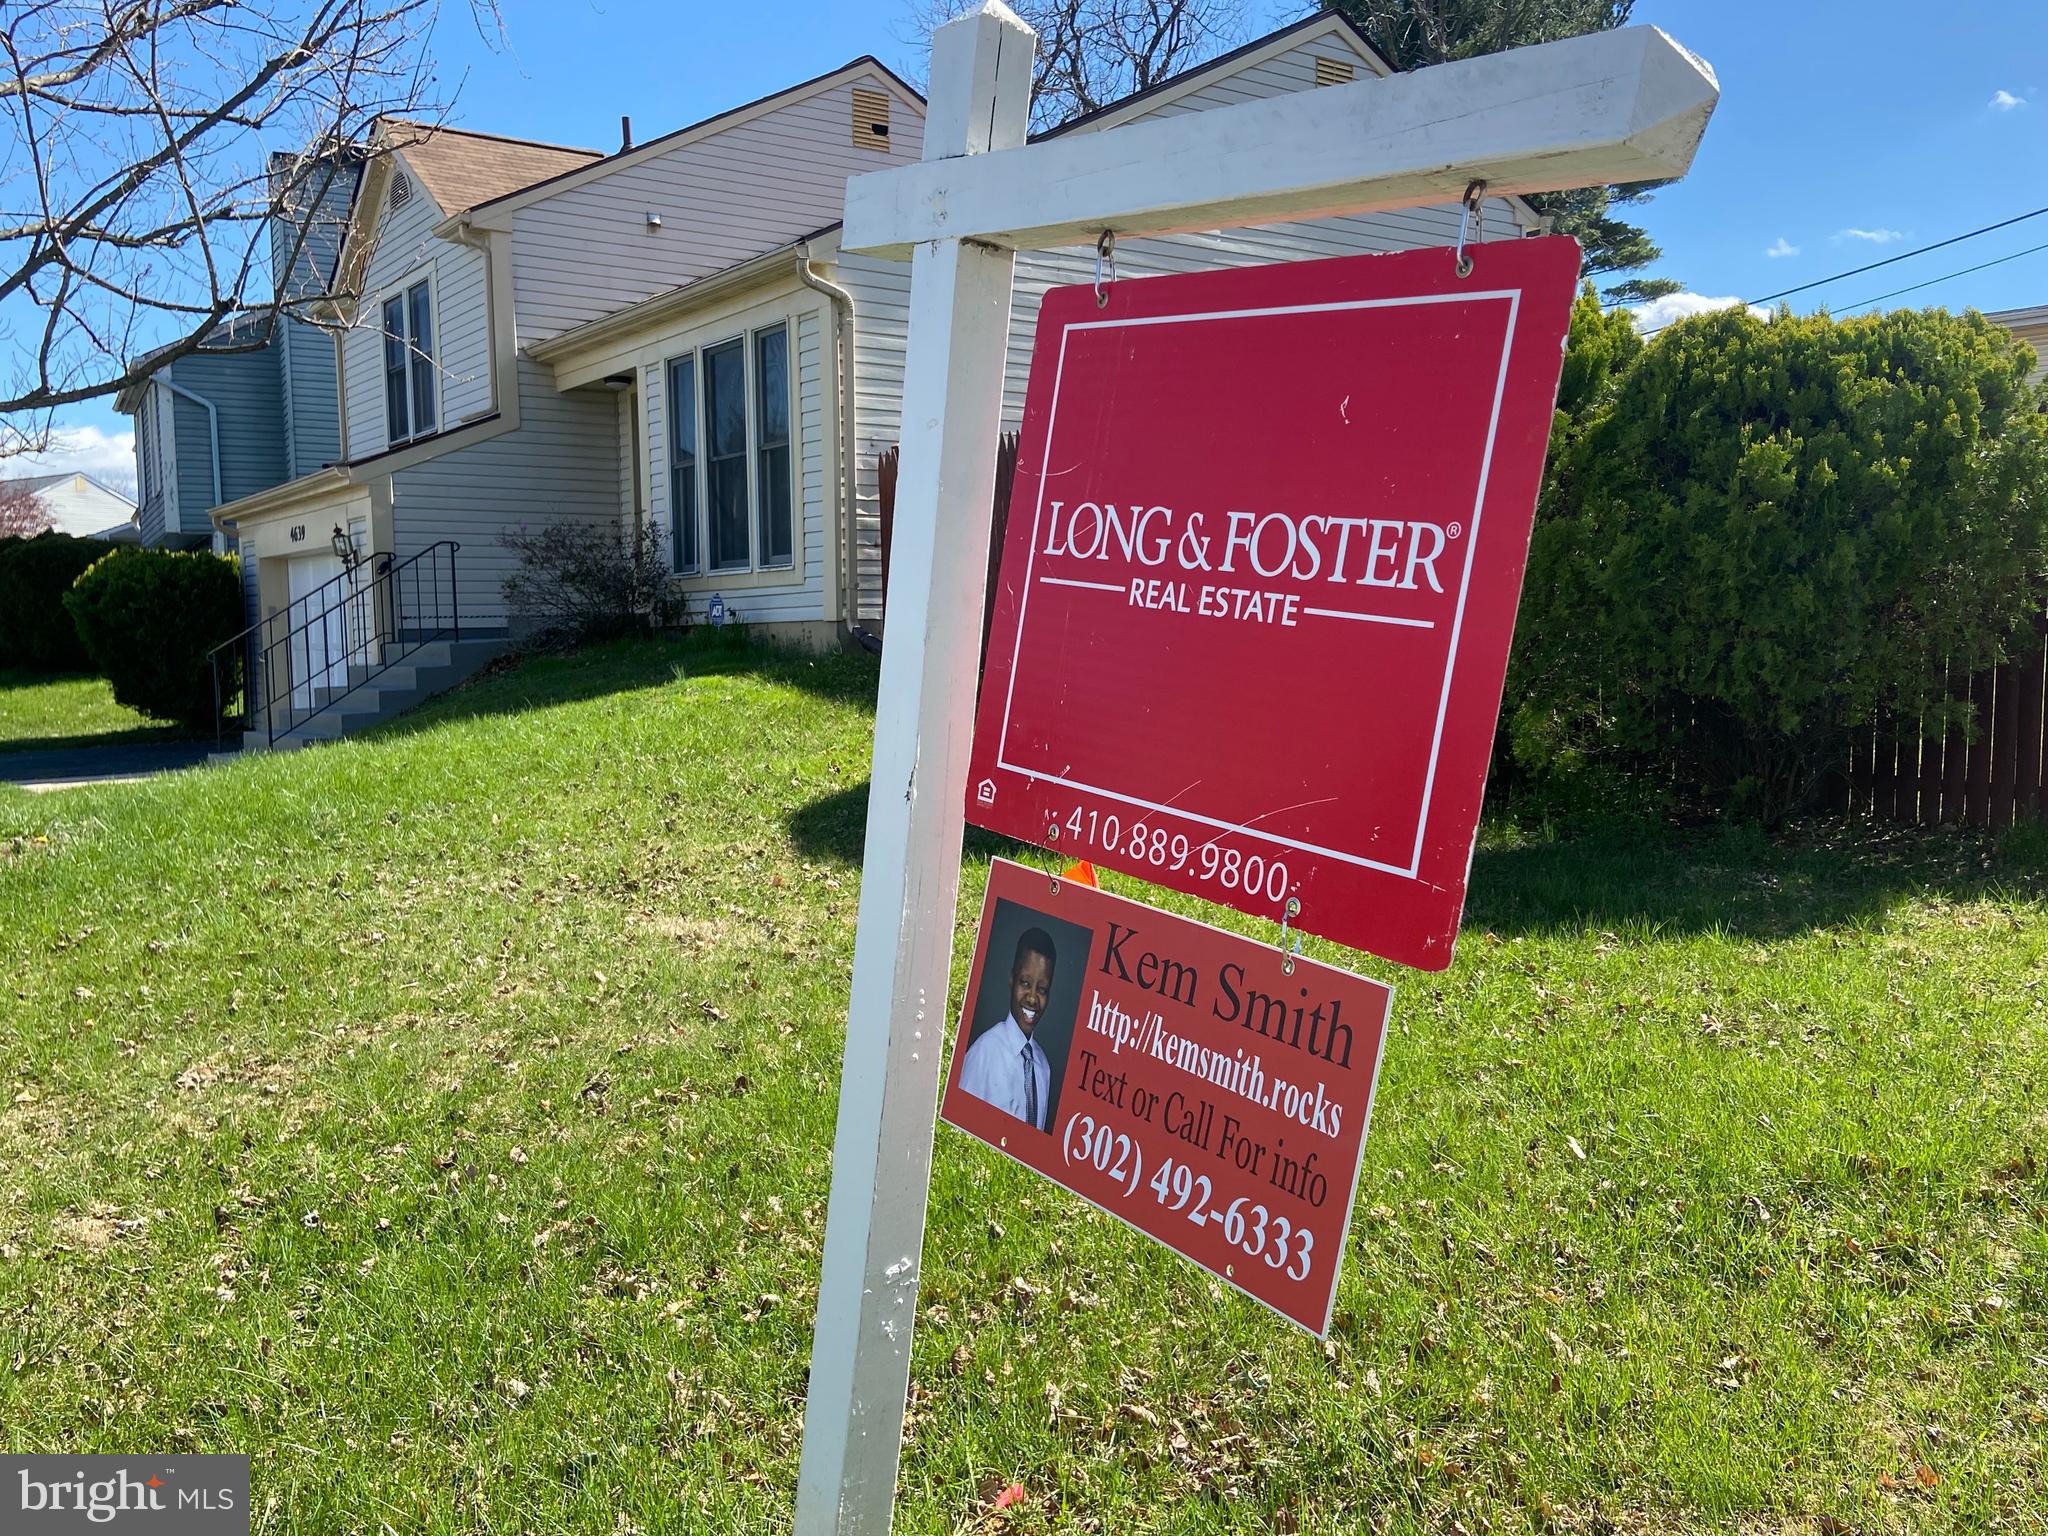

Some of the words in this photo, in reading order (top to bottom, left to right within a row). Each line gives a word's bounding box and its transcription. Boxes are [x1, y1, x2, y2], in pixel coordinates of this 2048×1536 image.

[1043, 501, 1172, 566] LONG
[1178, 513, 1212, 572] &
[1129, 578, 1191, 613] REAL
[1198, 586, 1300, 627] ESTATE
[1066, 806, 1288, 902] 410.889.9800
[1086, 991, 1343, 1139] http://kemsmith.rocks
[1099, 921, 1199, 1008] Kem
[1212, 963, 1353, 1070] Smith
[1063, 1112, 1143, 1198] (302)
[1150, 1157, 1315, 1282] 492-6333
[1078, 1049, 1124, 1110] Text
[1131, 1087, 1159, 1123] or
[1163, 1092, 1214, 1151] Call
[1217, 1114, 1266, 1176] For
[1269, 1138, 1328, 1208] info
